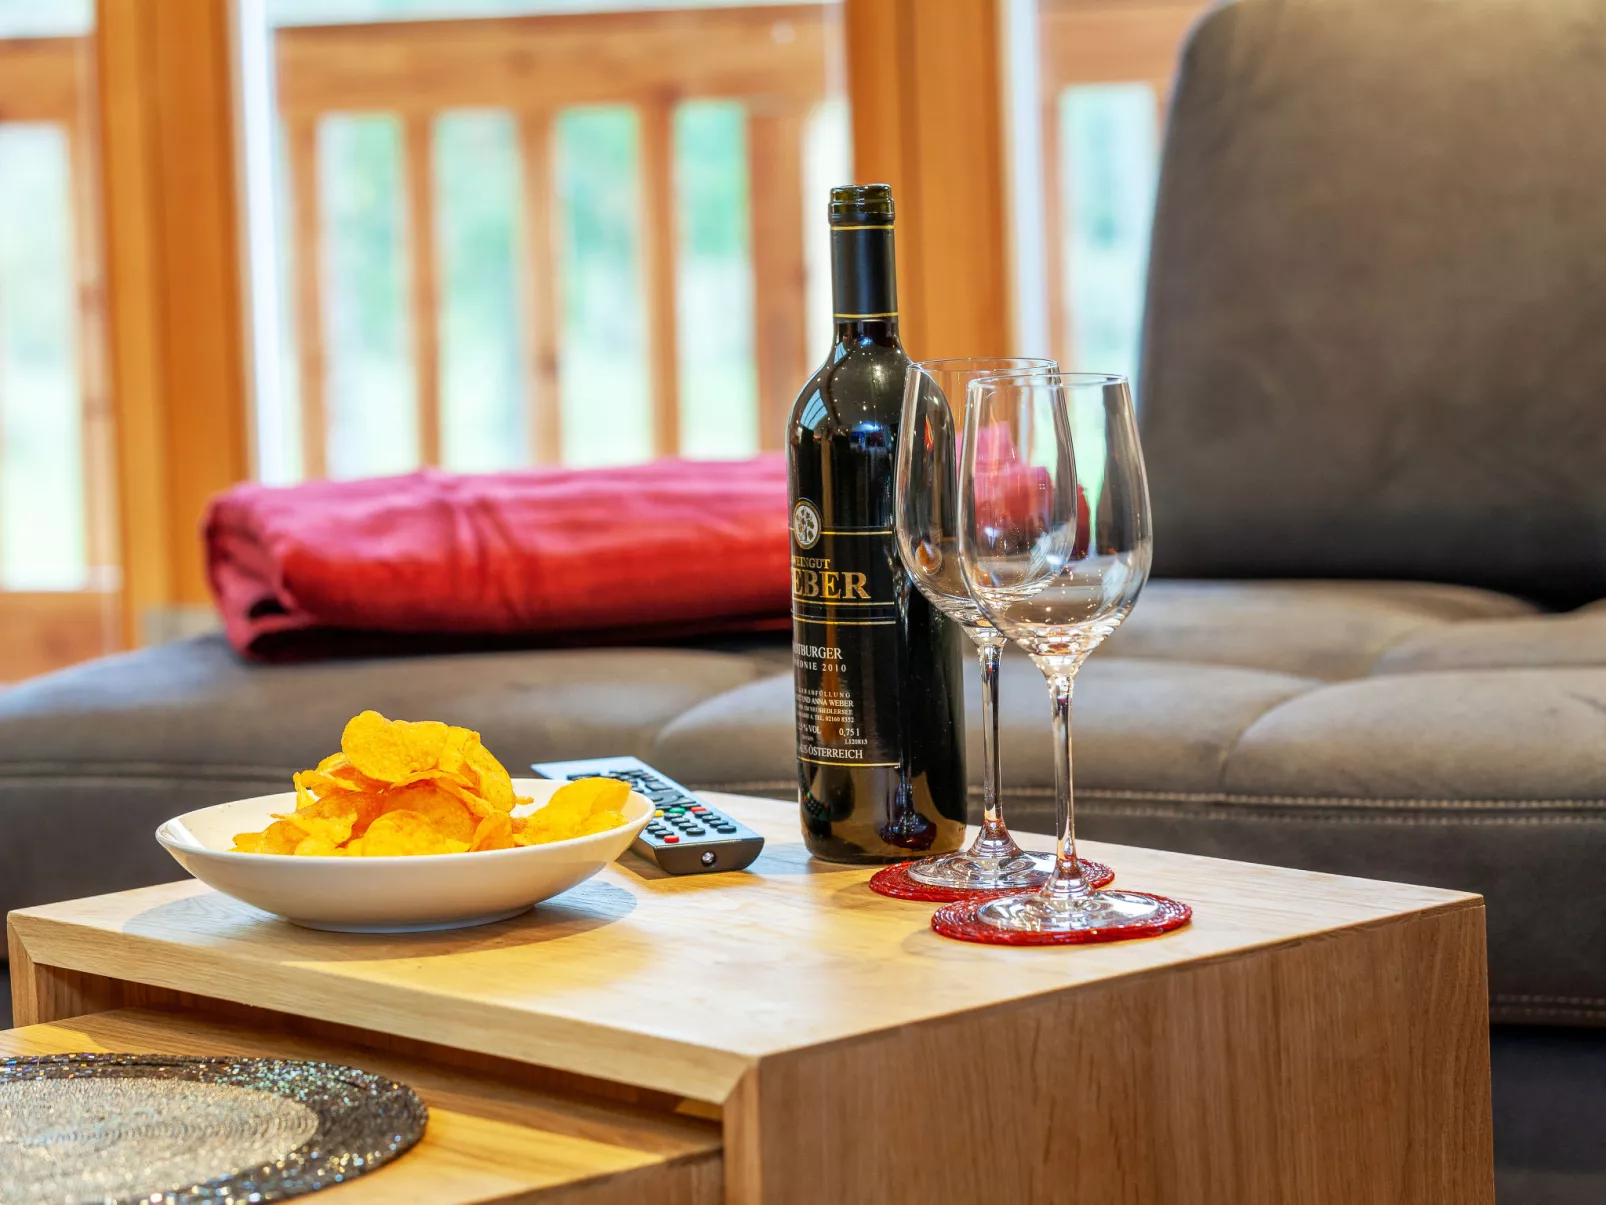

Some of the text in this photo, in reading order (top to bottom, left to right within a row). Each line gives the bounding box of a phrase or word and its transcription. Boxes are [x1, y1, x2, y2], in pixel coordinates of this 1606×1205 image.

[822, 663, 847, 673] 2010
[828, 699, 855, 707] WEBER
[838, 728, 855, 737] 0,75
